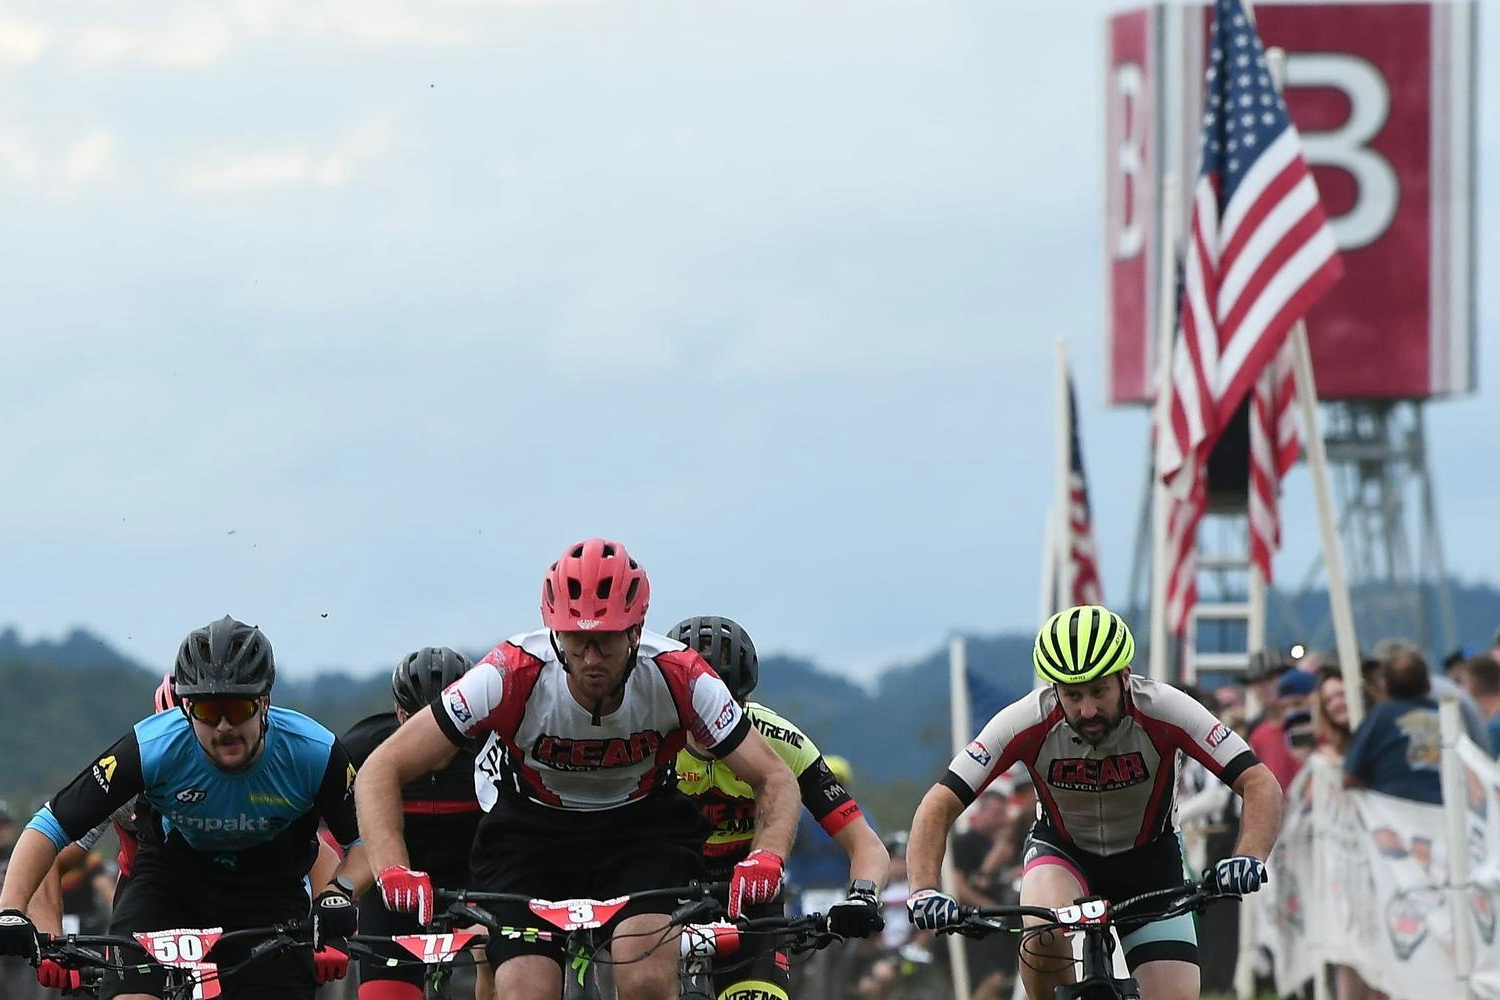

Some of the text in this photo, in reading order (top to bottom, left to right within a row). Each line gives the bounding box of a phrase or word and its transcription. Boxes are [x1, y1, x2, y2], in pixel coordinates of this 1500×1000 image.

[1052, 752, 1145, 784] GEAR
[567, 904, 594, 923] 3
[153, 934, 203, 962] 50
[420, 934, 454, 953] 77
